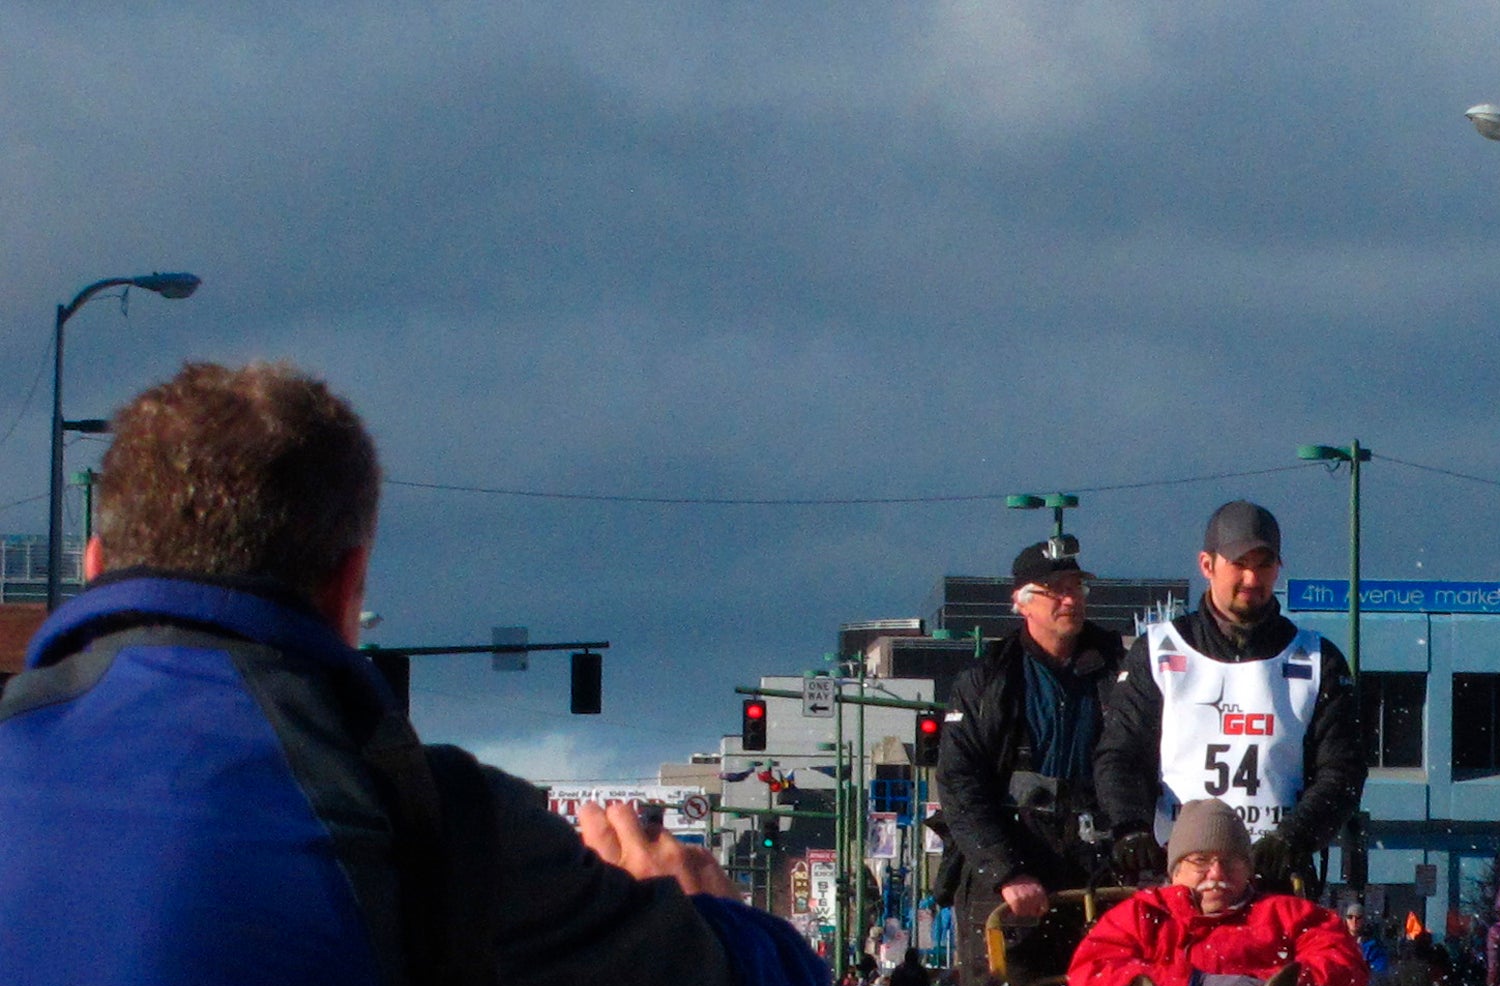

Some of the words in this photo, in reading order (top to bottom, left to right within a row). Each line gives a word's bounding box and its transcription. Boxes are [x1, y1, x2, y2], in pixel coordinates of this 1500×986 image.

[1302, 584, 1334, 603] 4th
[808, 681, 830, 691] ONE
[808, 692, 830, 701] WAY
[1223, 713, 1274, 736] GCI
[1204, 743, 1261, 796] 54
